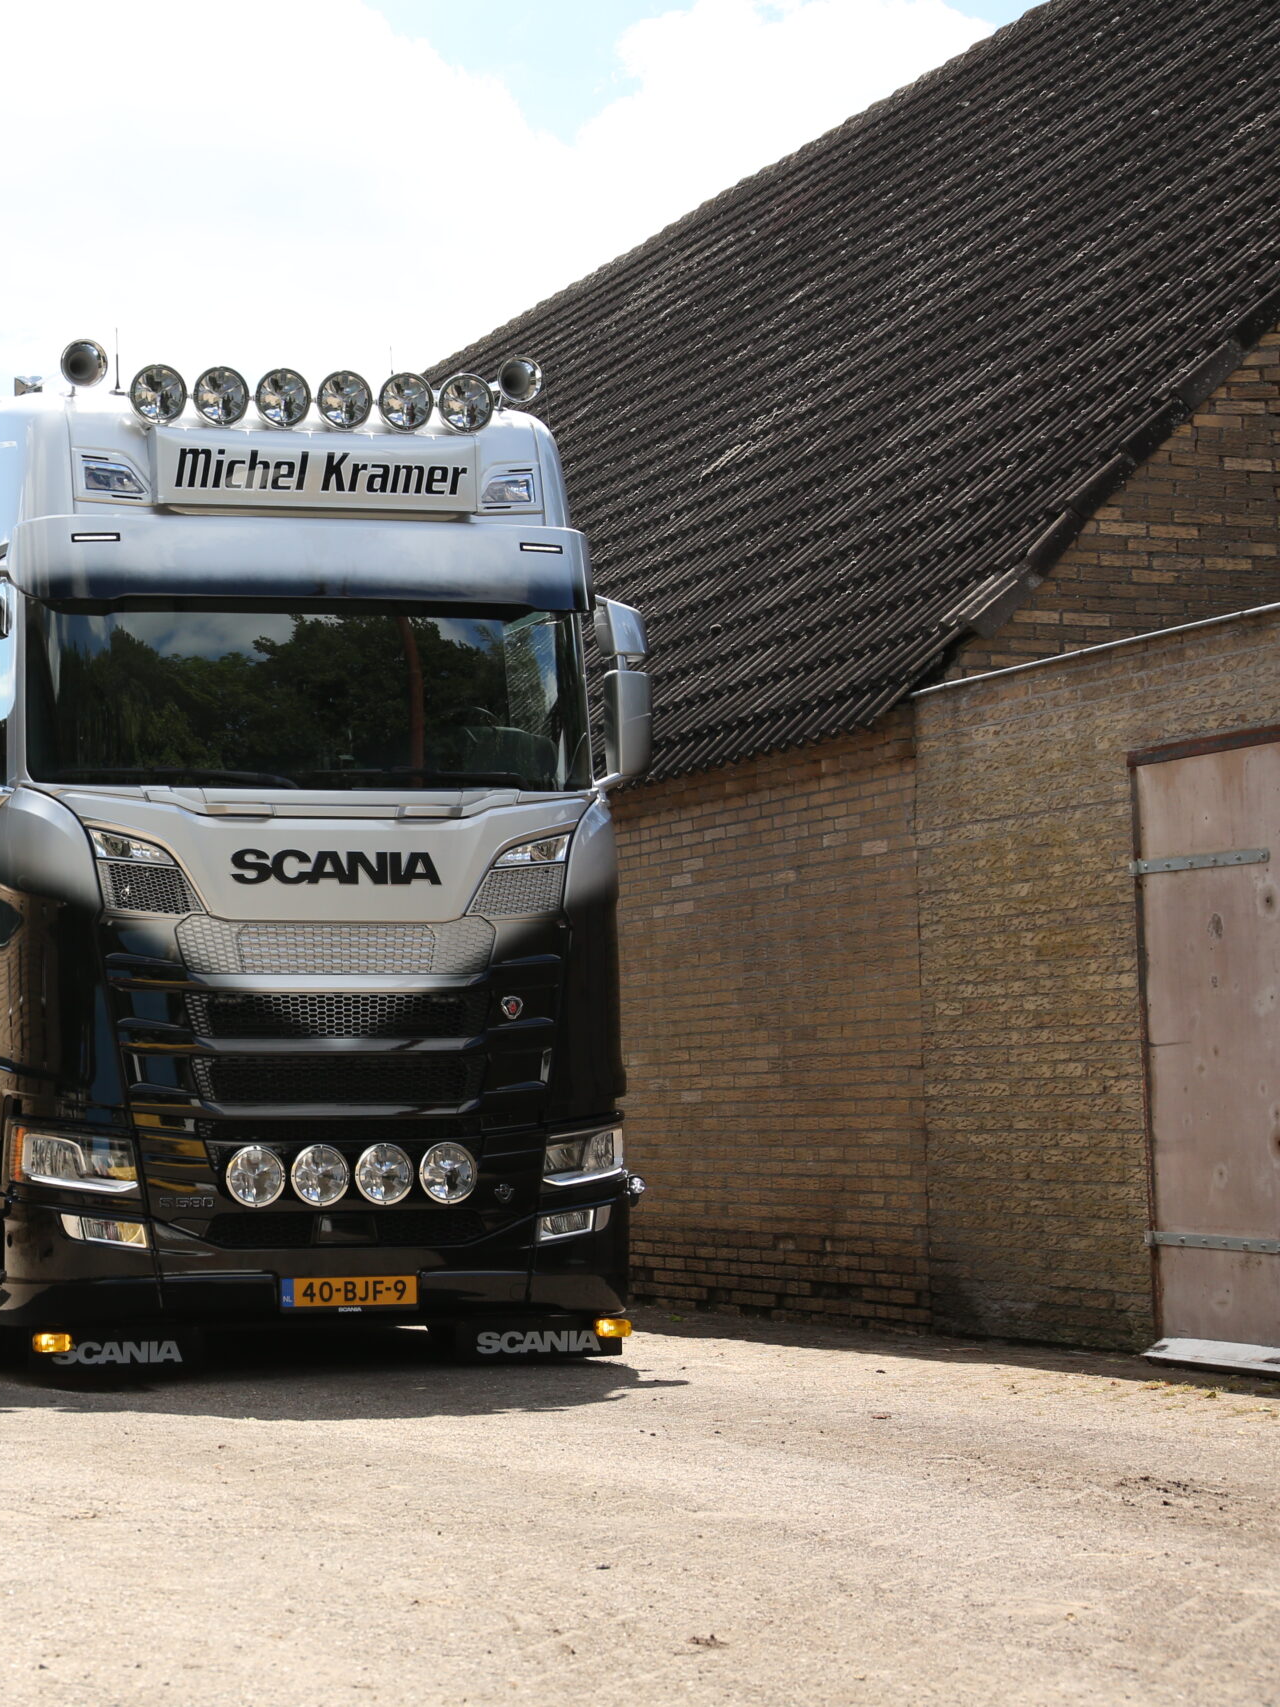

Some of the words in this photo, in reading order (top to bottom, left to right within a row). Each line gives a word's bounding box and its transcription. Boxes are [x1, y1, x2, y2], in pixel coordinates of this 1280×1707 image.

[174, 447, 310, 491] Michel
[320, 451, 468, 496] Kramer
[230, 848, 443, 885] SCANIA
[282, 1295, 293, 1303] NL
[302, 1280, 407, 1303] 40-BJF-9
[476, 1330, 602, 1354] SCANIA
